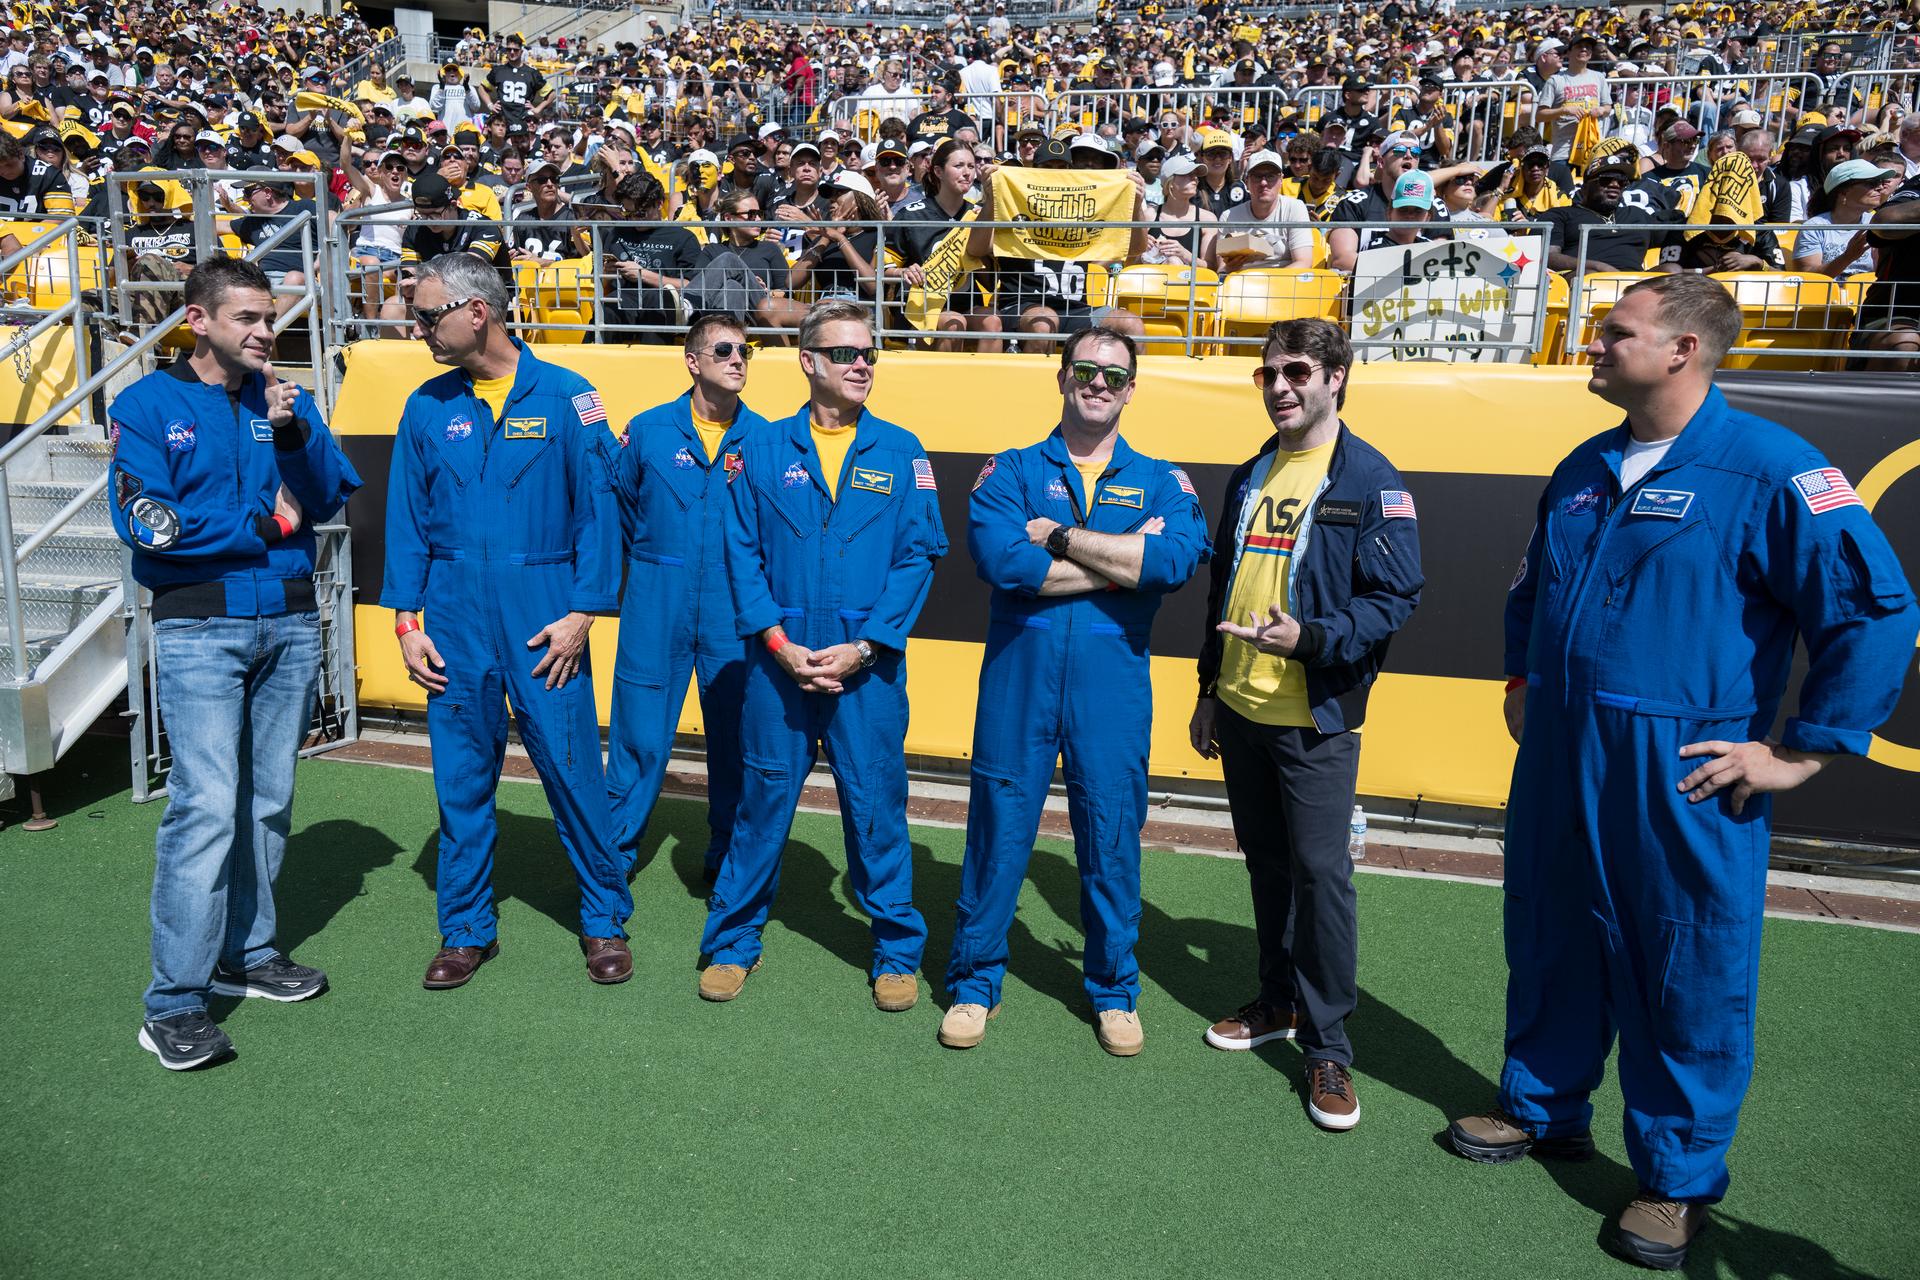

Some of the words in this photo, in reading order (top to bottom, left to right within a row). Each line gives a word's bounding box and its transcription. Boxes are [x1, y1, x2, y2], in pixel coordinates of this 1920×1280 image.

[502, 80, 528, 105] 92
[1027, 193, 1096, 219] terrible
[642, 242, 673, 250] FALCONS
[1402, 241, 1481, 286] Let's
[1362, 287, 1416, 336] get
[1426, 296, 1444, 317] a
[1459, 283, 1509, 316] win
[447, 423, 472, 432] NASA
[167, 429, 196, 442] NASA
[784, 470, 810, 481] NASA
[1049, 484, 1068, 493] NAS
